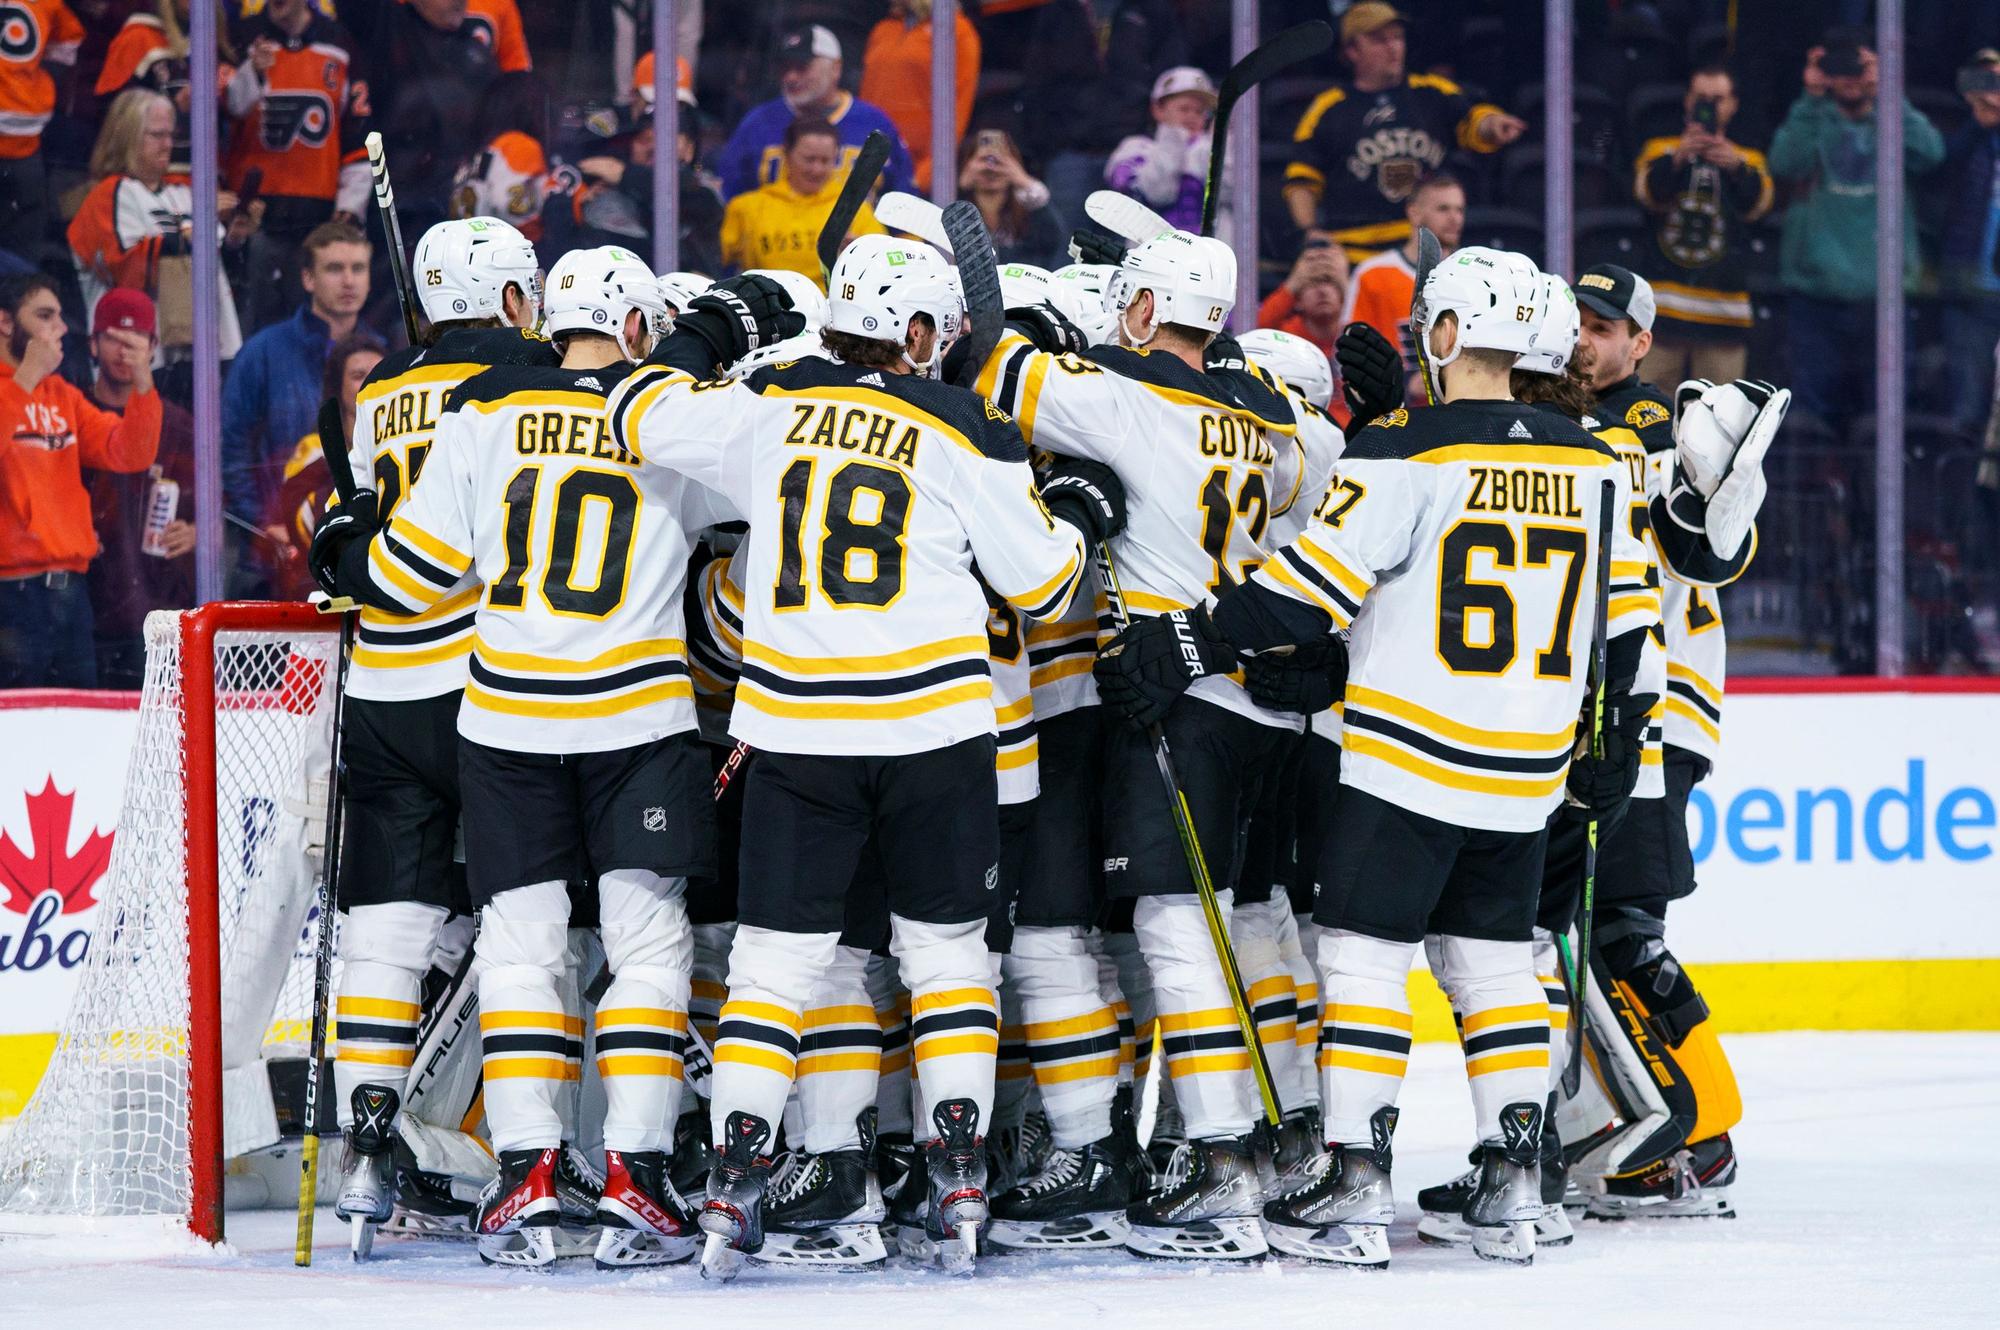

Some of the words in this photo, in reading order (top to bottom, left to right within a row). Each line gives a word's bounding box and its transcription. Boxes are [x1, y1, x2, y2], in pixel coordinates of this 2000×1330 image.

[1347, 128, 1446, 182] BOSTON
[1171, 233, 1193, 246] Bank
[1474, 257, 1495, 268] Bank
[426, 269, 442, 286] 25
[560, 274, 575, 290] 10
[842, 283, 855, 301] 18
[1207, 305, 1223, 323] 13
[1516, 305, 1534, 323] 67
[574, 379, 604, 392] adidas
[856, 376, 886, 389] adidas
[784, 402, 922, 471] ZACHA
[1508, 431, 1533, 439] adidas
[1464, 465, 1584, 520] ZBORIL
[487, 462, 644, 623] 10
[773, 455, 917, 614] 18
[1435, 518, 1588, 681] 67
[1169, 609, 1205, 678] AUER
[316, 888, 328, 963] JETSPEED
[407, 990, 479, 1105] TRUE
[1610, 978, 1676, 1089] TRUE
[304, 1056, 317, 1128] CCM
[484, 1185, 533, 1233] CCM
[618, 1186, 681, 1237] CCM
[1167, 1192, 1200, 1220] BAUER
[1300, 1194, 1333, 1218] BAUER
